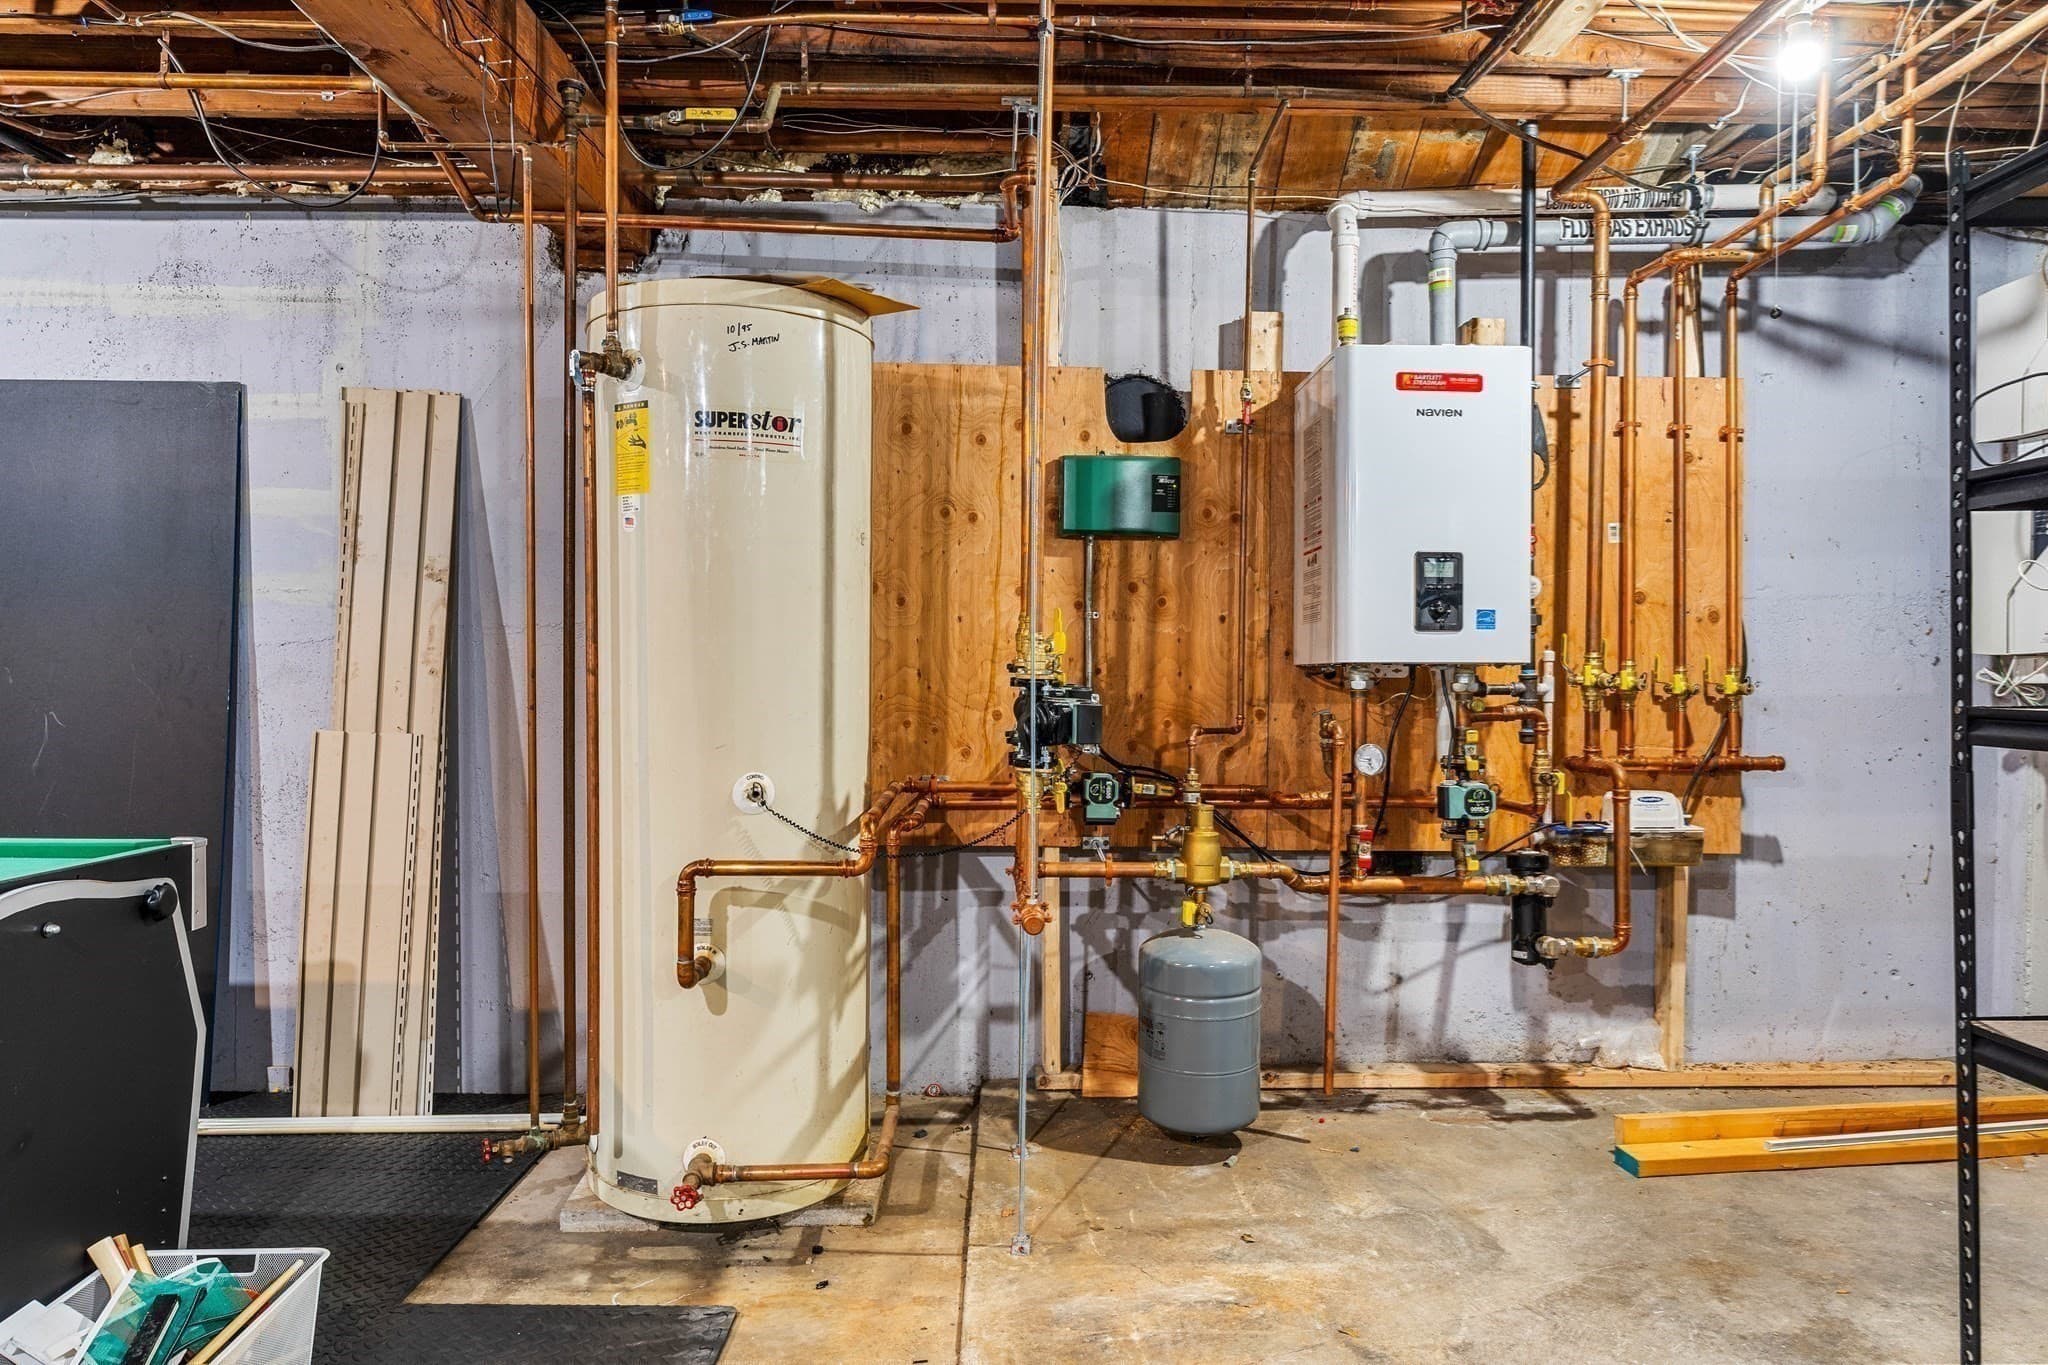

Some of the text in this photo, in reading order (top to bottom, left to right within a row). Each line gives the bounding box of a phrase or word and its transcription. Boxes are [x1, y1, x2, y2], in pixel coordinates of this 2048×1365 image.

[1608, 218, 1633, 238] AS
[1635, 218, 1696, 238] EXHAUS
[751, 333, 780, 346] MARTIN
